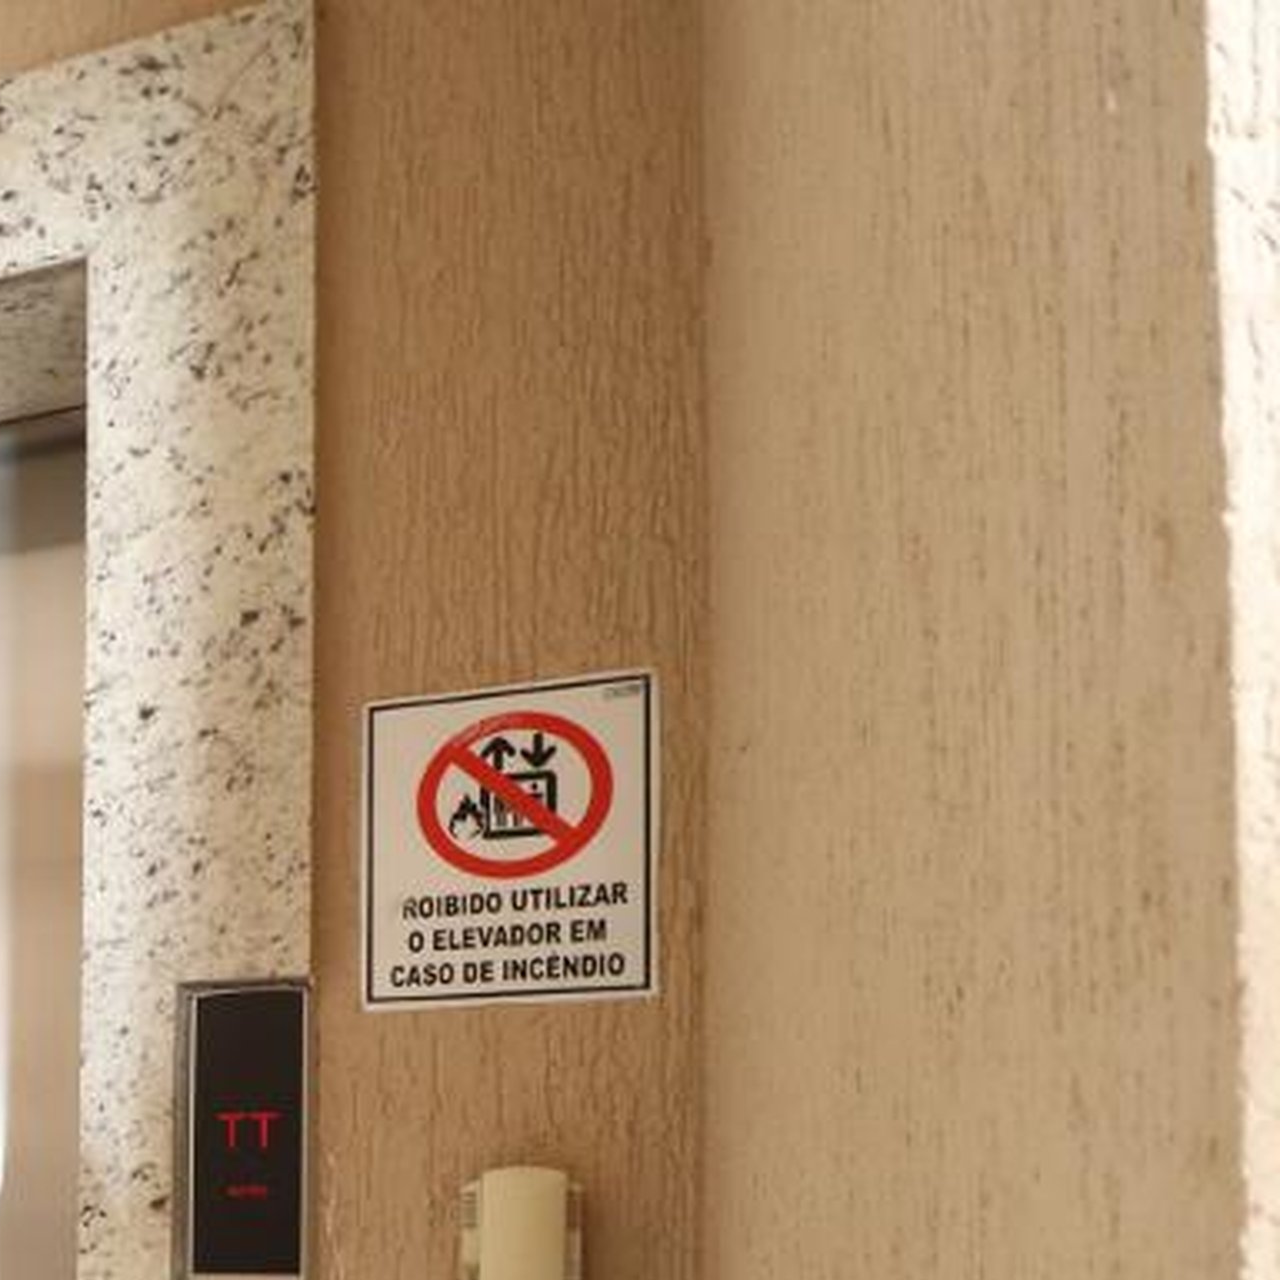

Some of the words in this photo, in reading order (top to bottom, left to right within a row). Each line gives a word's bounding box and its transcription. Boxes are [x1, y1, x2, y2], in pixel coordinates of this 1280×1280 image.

[511, 881, 628, 911] UTILIZAR
[408, 931, 425, 953] O
[432, 922, 562, 951] ELEVADOR
[570, 918, 607, 943] EM
[391, 963, 455, 987] CASO
[463, 960, 495, 984] DE
